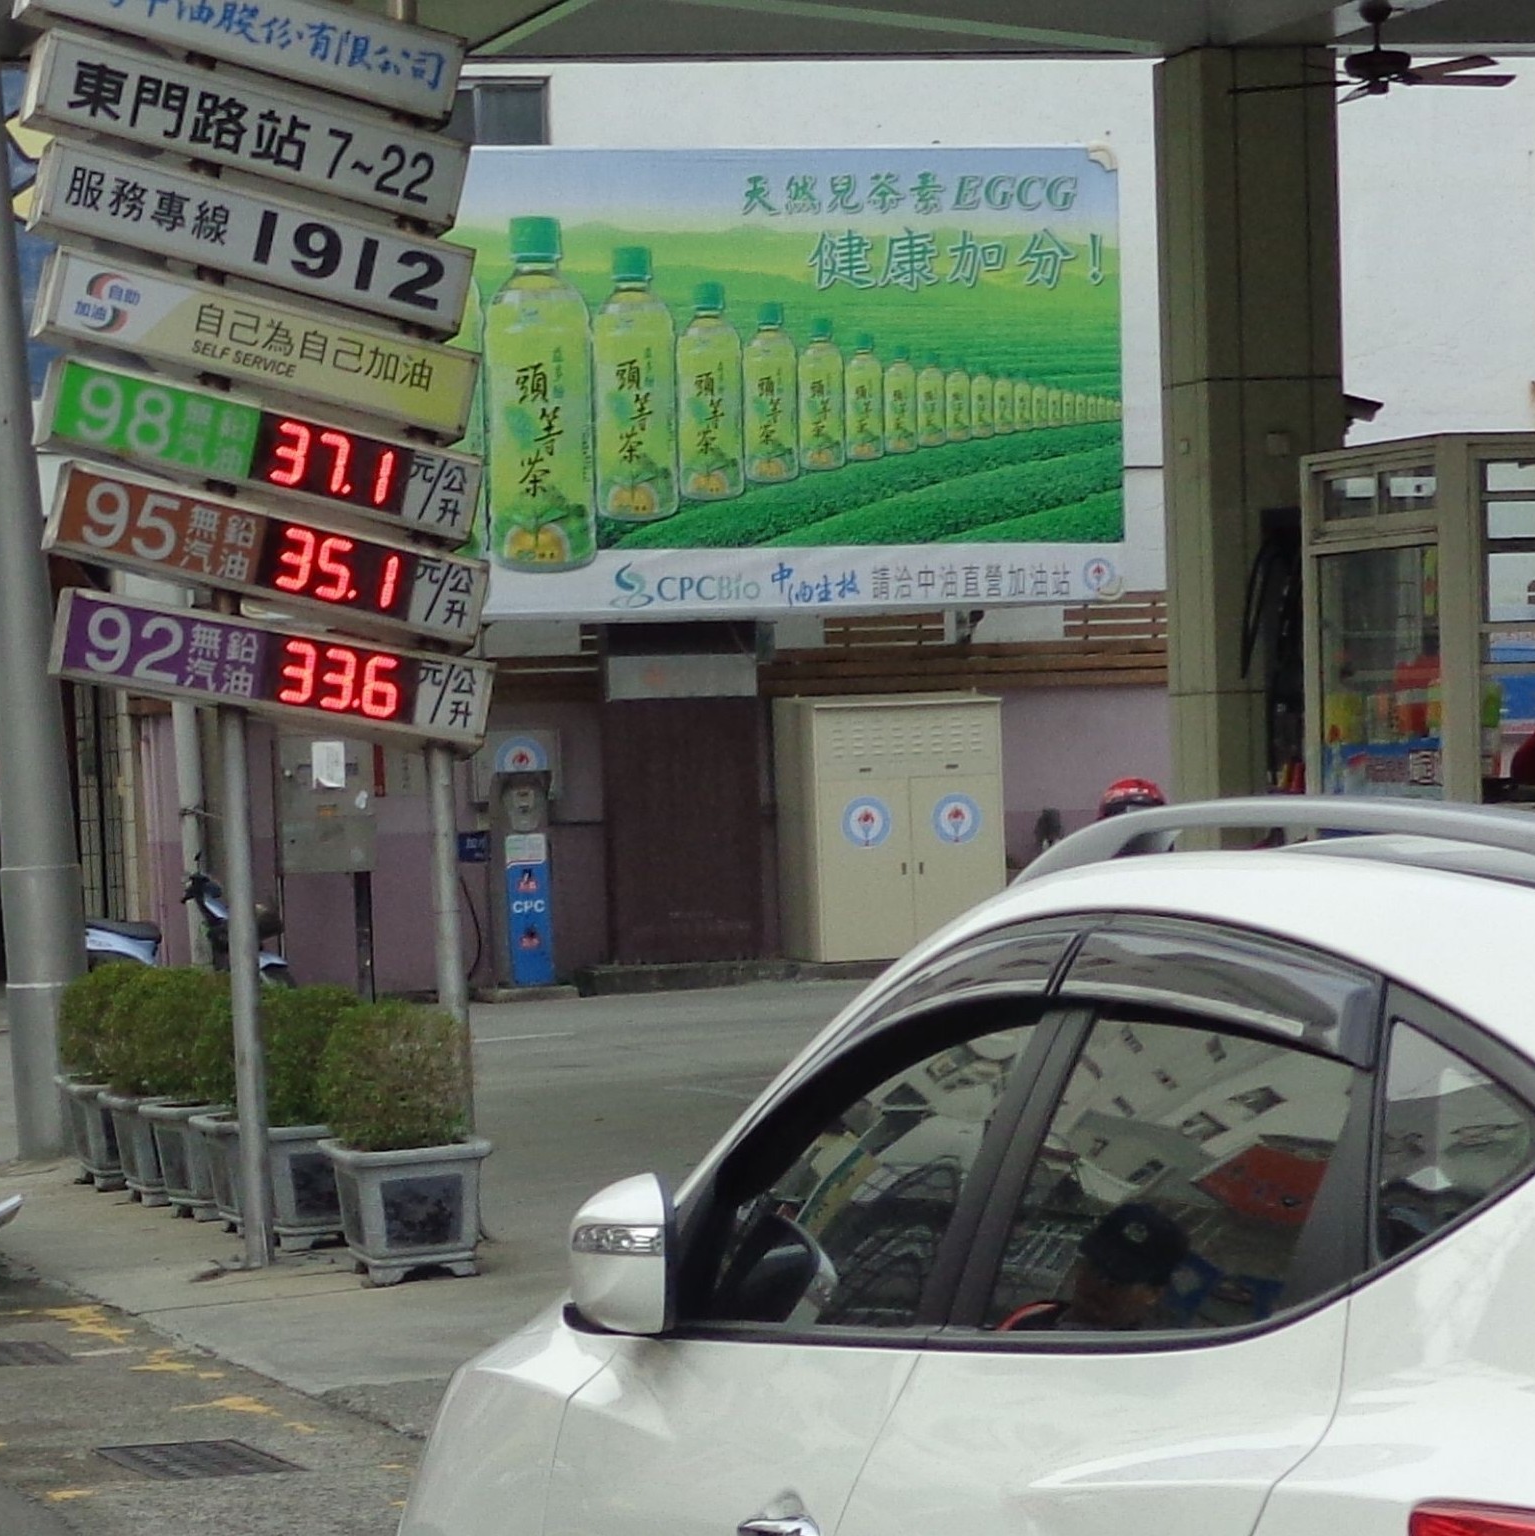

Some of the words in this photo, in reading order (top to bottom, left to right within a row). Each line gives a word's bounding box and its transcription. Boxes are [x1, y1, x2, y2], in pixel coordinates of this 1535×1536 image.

[108, 0, 446, 90] 油股份有限公司
[68, 60, 311, 171] 東門路站
[327, 129, 434, 204] 7~22
[66, 166, 230, 245] 服務專線
[253, 211, 444, 310] 1912
[74, 300, 107, 321] 加油
[108, 284, 141, 306] 自助
[192, 340, 233, 365] SELF
[232, 351, 297, 379] SERVICE
[194, 304, 433, 393] 自己為自己加油
[80, 376, 173, 454] 98
[516, 362, 564, 498] 頭等茶
[616, 359, 653, 464] 頭等茶
[271, 420, 394, 504] 37.1
[82, 483, 177, 561] 95
[276, 527, 398, 609] 35.1
[85, 606, 184, 684] 92
[279, 638, 397, 720] 33.6
[513, 899, 546, 914] CPC
